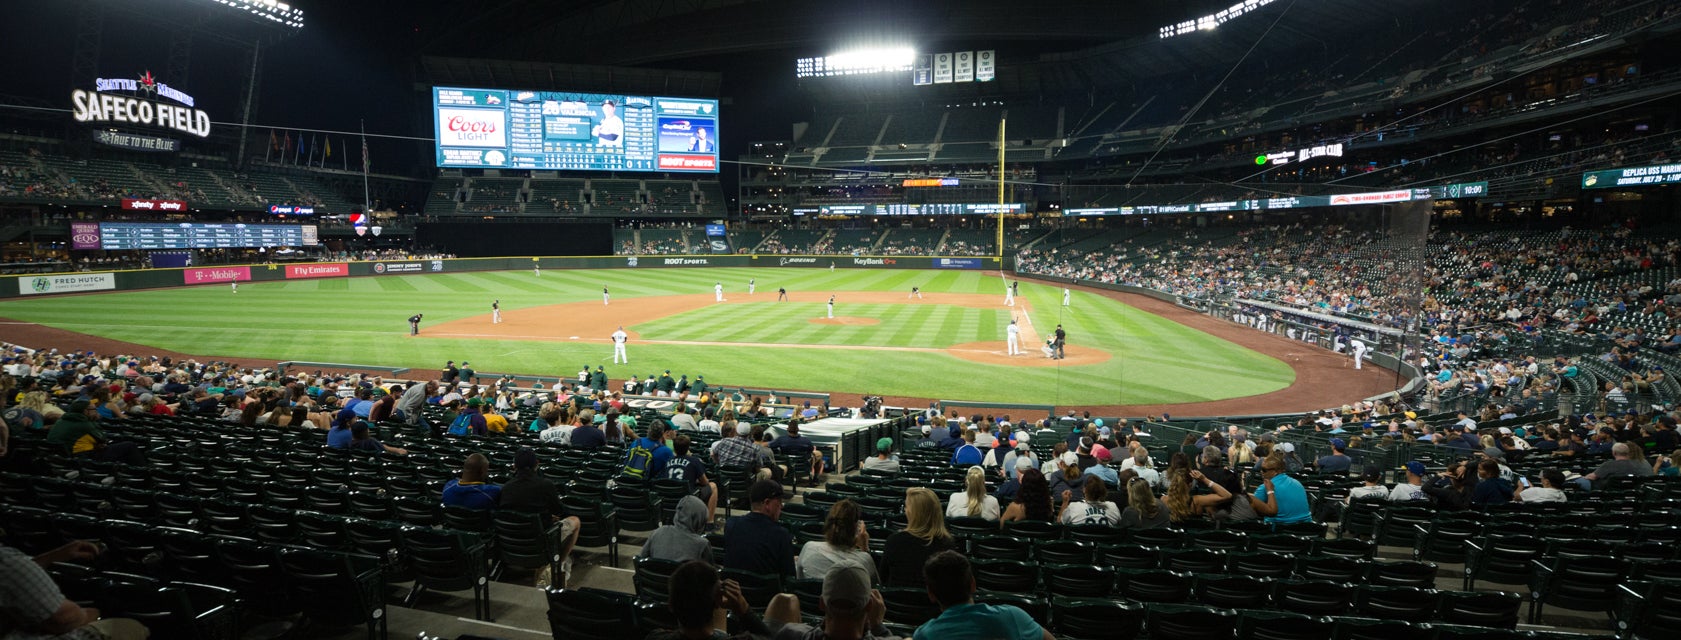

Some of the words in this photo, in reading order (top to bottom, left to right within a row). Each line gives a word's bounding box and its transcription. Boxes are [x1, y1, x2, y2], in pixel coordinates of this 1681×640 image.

[72, 89, 154, 124] SAFECO
[157, 103, 211, 138] FIELD
[447, 116, 497, 133] Coors
[457, 132, 488, 141] LIGHT
[109, 133, 130, 146] TRUE
[131, 137, 140, 147] TO
[141, 138, 155, 149] THE
[156, 138, 174, 151] BLUE
[1326, 143, 1343, 157] CLUB
[626, 160, 633, 169] 0
[636, 160, 642, 169] 1
[646, 160, 652, 169] 1
[660, 157, 685, 166] ROOT
[1622, 167, 1647, 177] REPLICA
[1648, 166, 1660, 175] USS
[1642, 176, 1656, 184] JULY
[1464, 185, 1482, 195] 10:00
[131, 200, 154, 209] xfinity
[160, 201, 181, 210] xfinity
[73, 234, 99, 244] EQC
[294, 266, 308, 275] Fly
[308, 266, 341, 274] Emirates
[79, 276, 105, 284] HUTCH
[668, 468, 685, 480] 13
[1085, 506, 1106, 517] JONES
